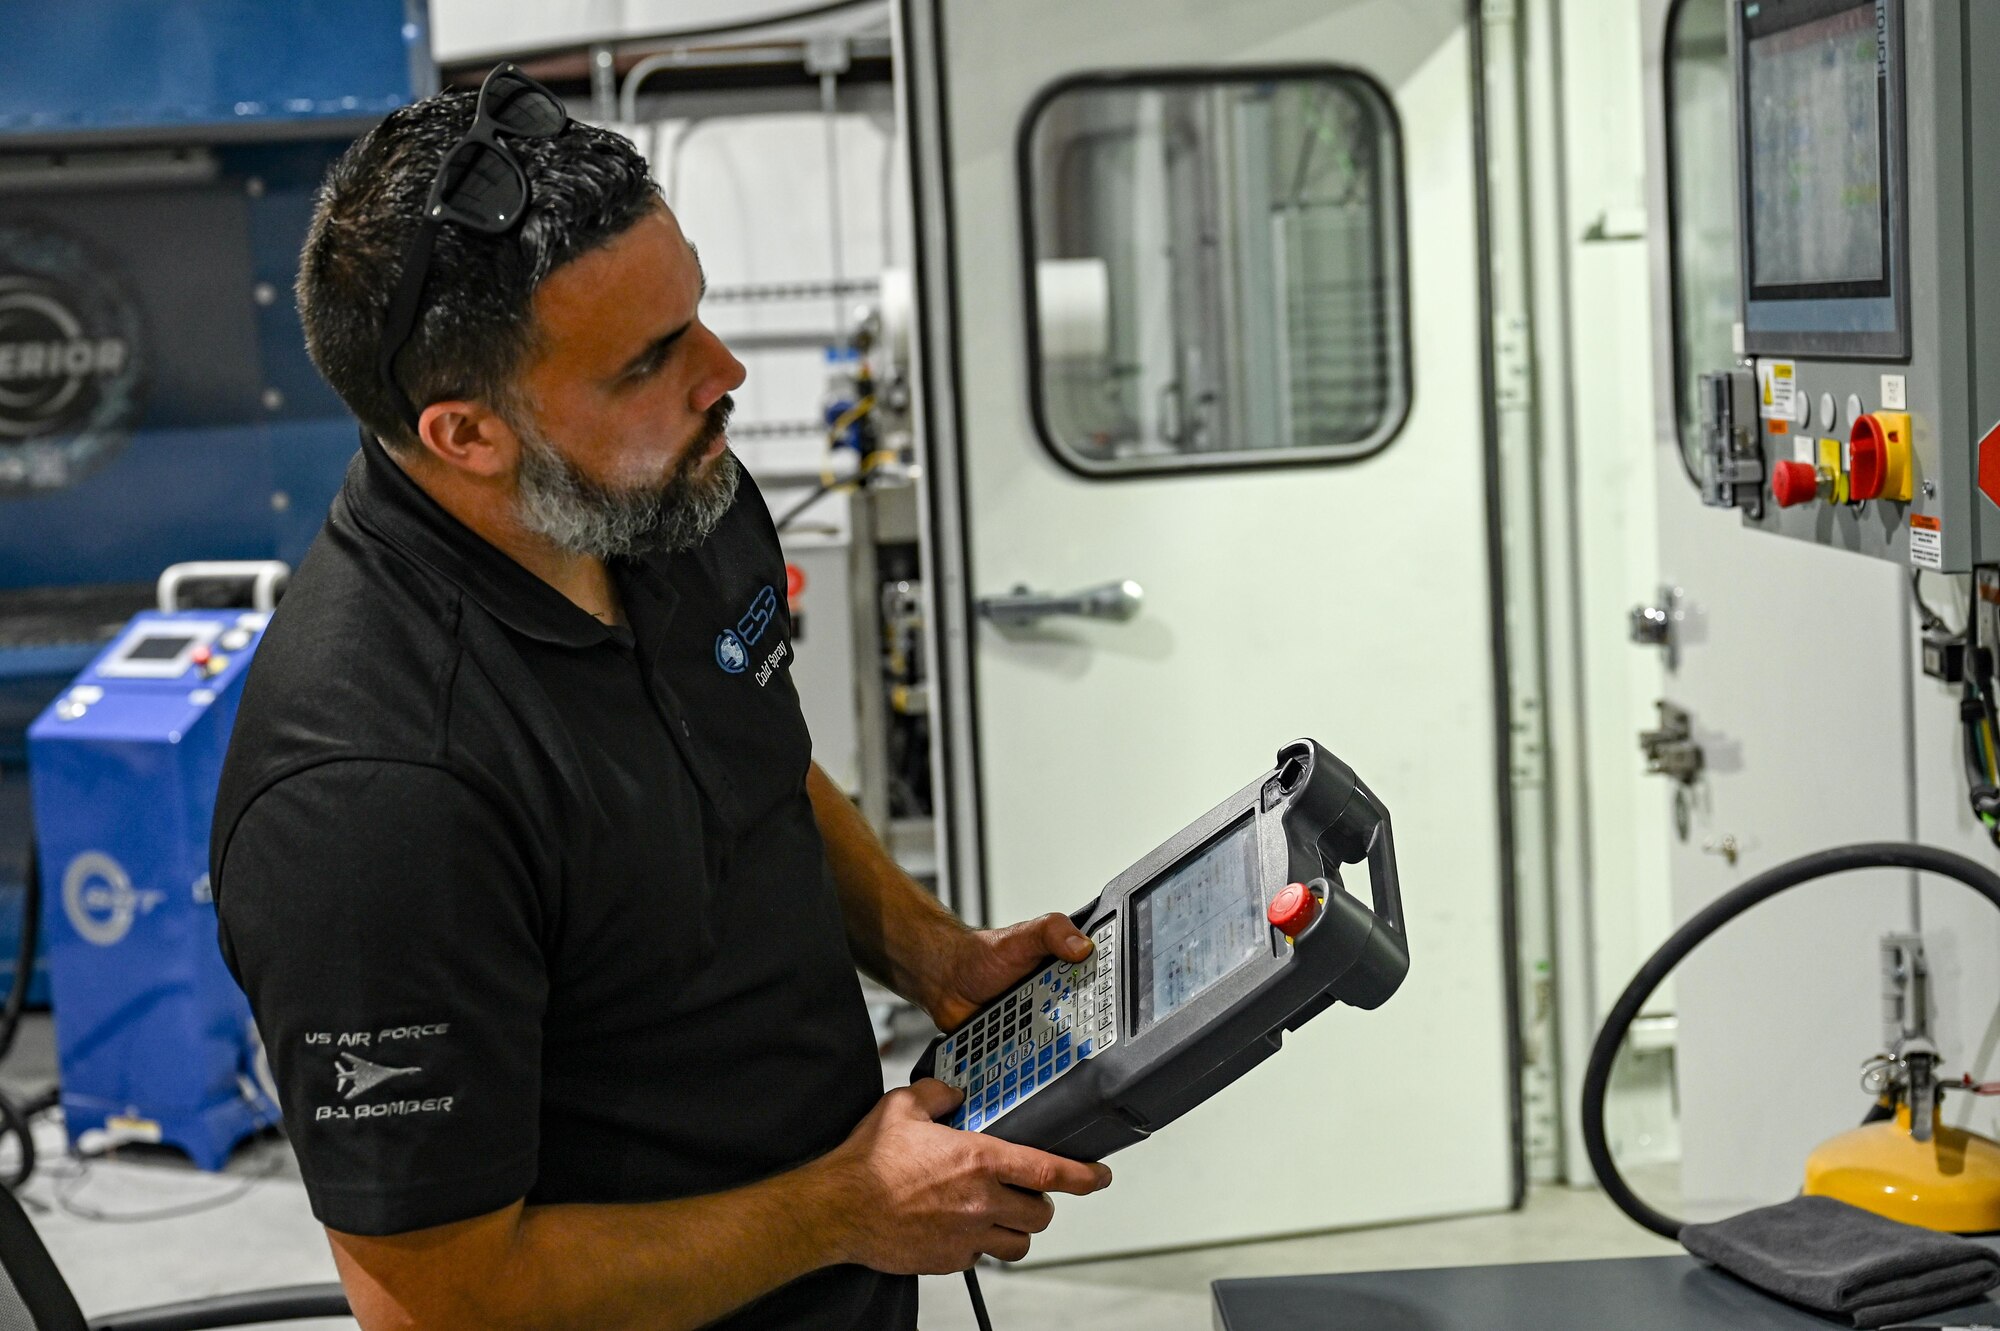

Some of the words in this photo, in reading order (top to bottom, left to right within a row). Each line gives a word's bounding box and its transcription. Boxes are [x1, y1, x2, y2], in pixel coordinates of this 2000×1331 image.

[1876, 5, 1886, 75] TOUCH
[755, 660, 773, 688] Cold
[767, 640, 788, 668] Spray
[305, 1032, 332, 1045] US
[337, 1032, 371, 1047] AIR
[378, 1023, 450, 1043] FORCE
[315, 1106, 350, 1121] B-1
[354, 1096, 454, 1121] BOMBER
